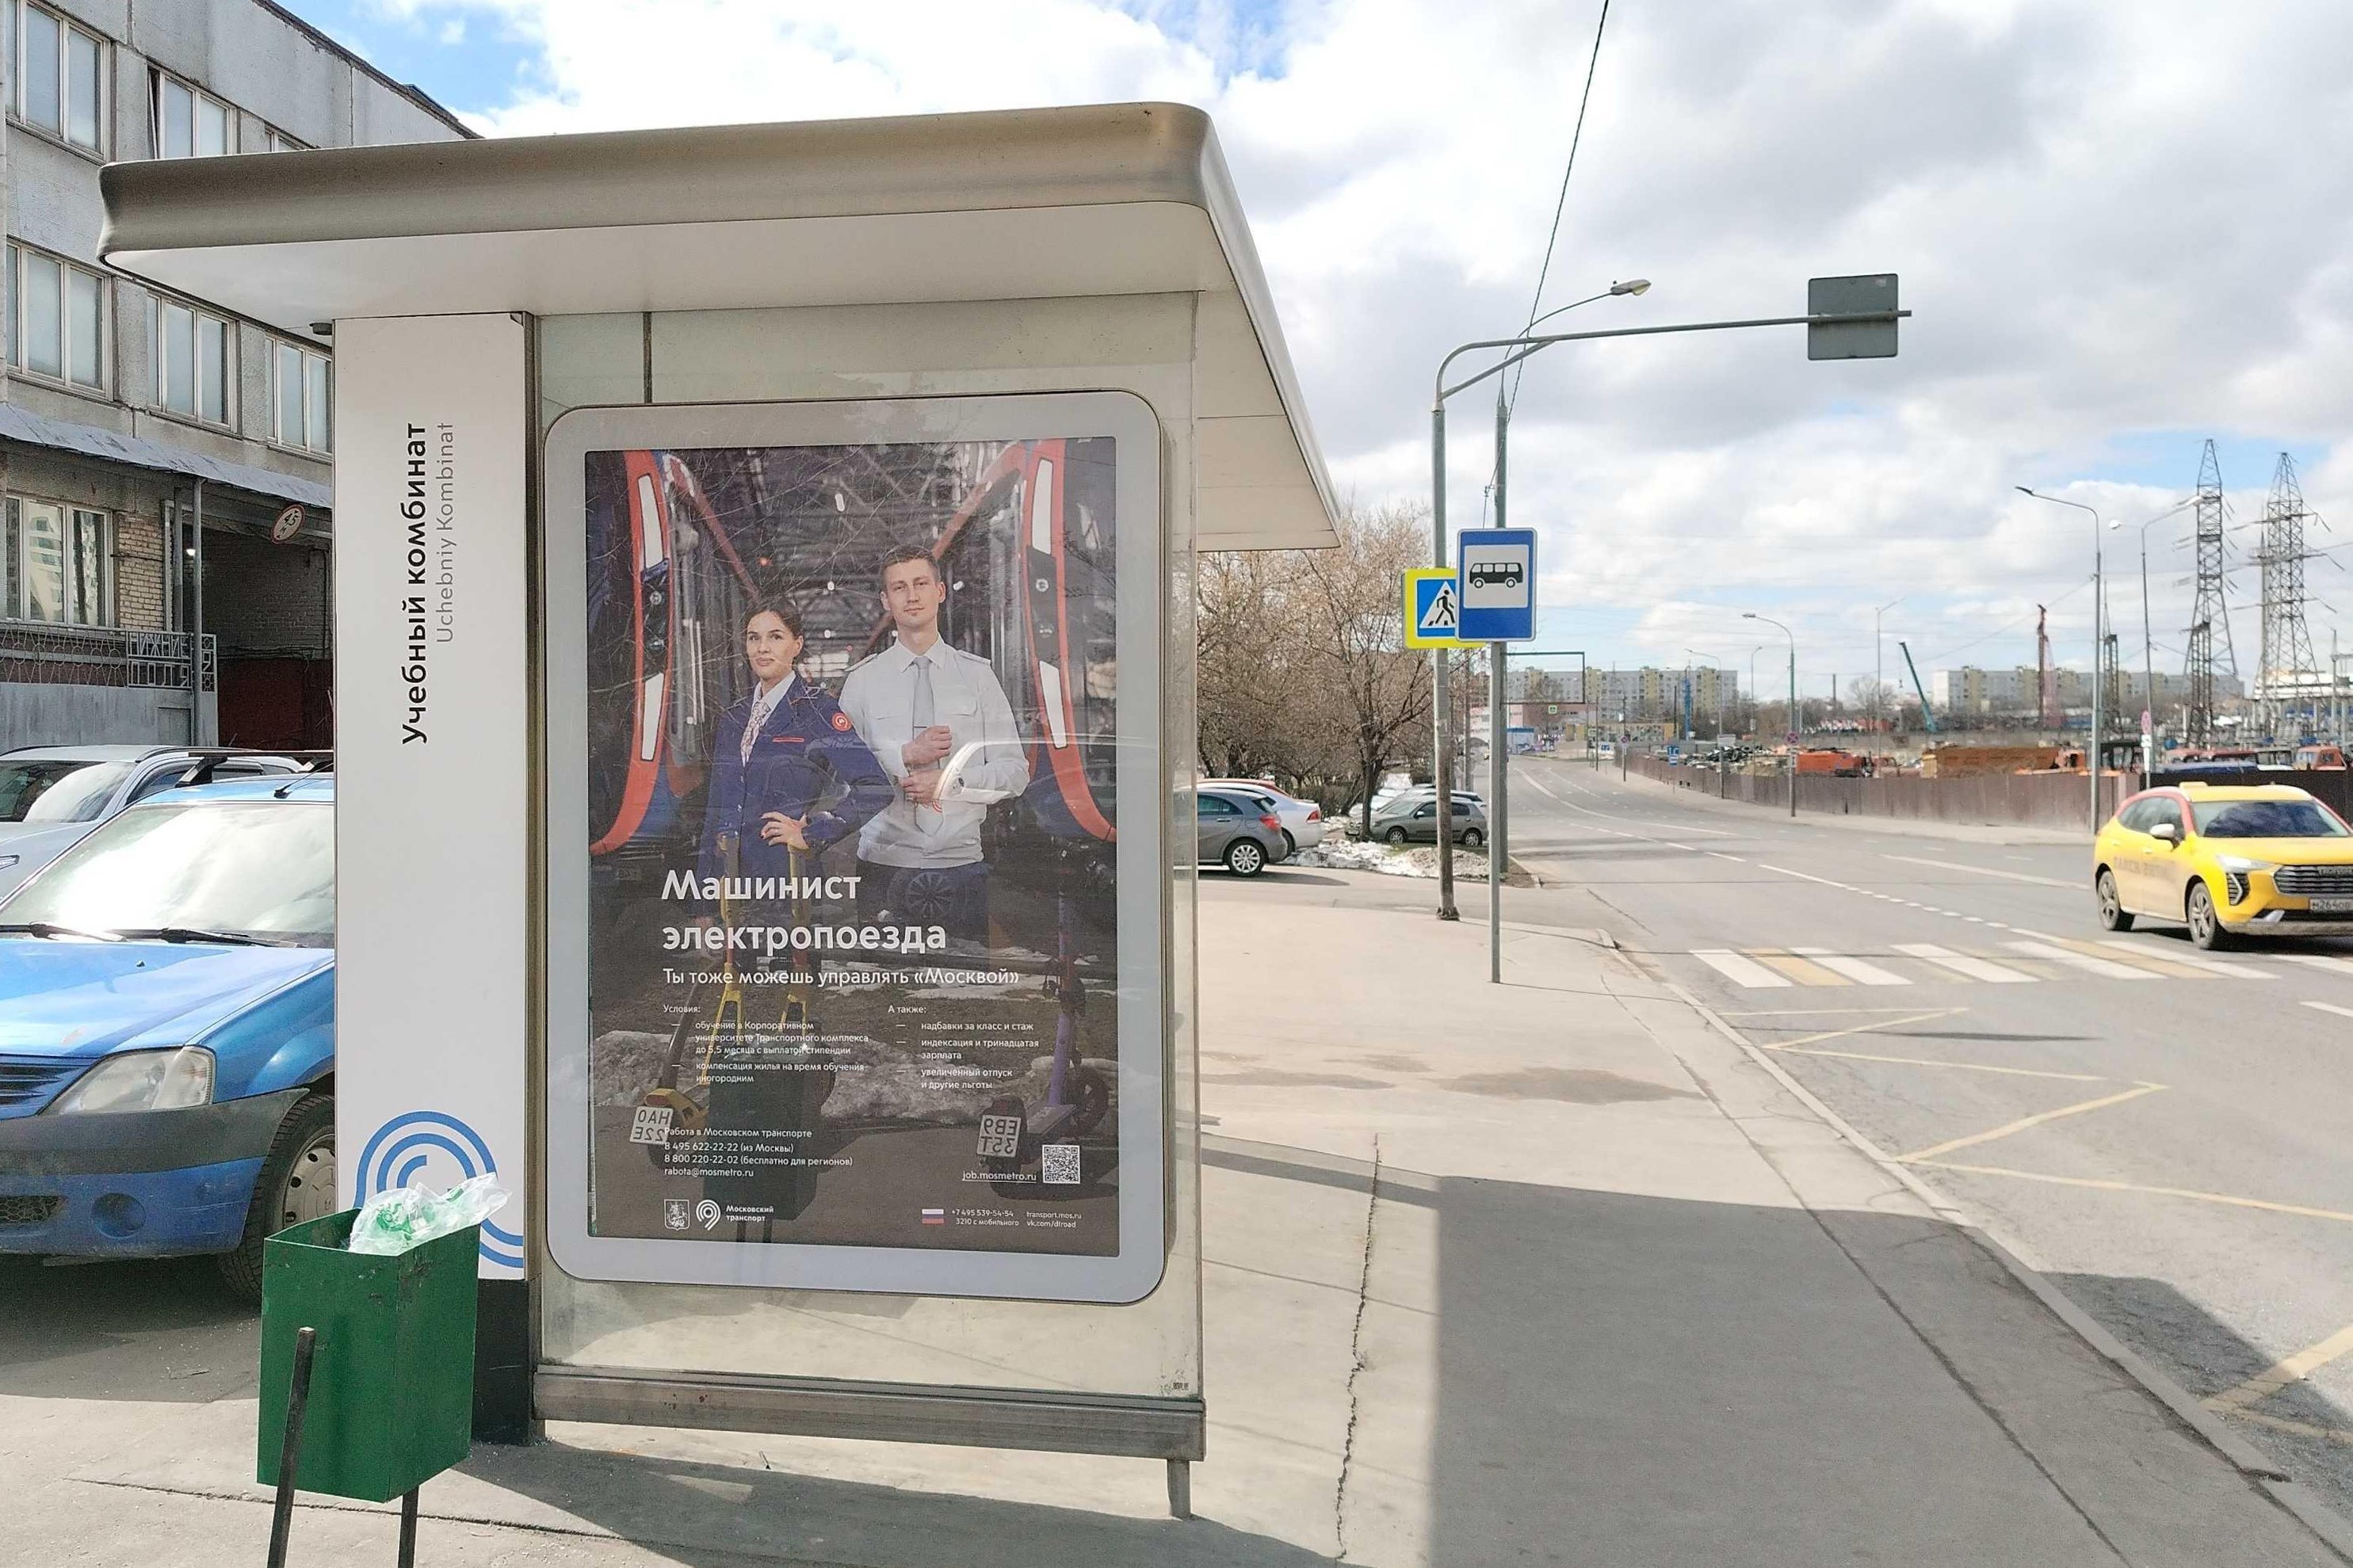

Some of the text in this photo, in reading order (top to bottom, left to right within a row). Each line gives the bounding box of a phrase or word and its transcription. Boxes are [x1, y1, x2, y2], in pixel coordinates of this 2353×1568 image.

[434, 422, 457, 643] Uchebniy Kombinat
[400, 422, 428, 745] Учебный комбинат
[661, 869, 862, 901] Машинист
[662, 924, 947, 956] электропоезда
[663, 967, 1020, 987] Ты тоже можешь управлять «Москвой»
[663, 1005, 701, 1014] Условия:
[888, 1005, 895, 1013] А
[695, 1021, 735, 1032] обучение
[744, 1021, 814, 1032] Корпоративном
[921, 1021, 963, 1032] надбавки
[695, 1034, 869, 1044] университете Транспортного комплекса
[921, 1040, 973, 1048] индексация
[983, 1040, 1039, 1049] тринадцатая
[724, 1047, 755, 1056] месяца
[763, 1046, 804, 1055] выплатой
[806, 1047, 851, 1056] стипендии
[696, 1063, 753, 1072] компенсация
[794, 1064, 822, 1073] время
[823, 1063, 865, 1073] обучения
[921, 1068, 1013, 1078] увеличенный отпуск
[696, 1075, 754, 1085] иногородним
[929, 1082, 960, 1090] другие
[664, 1127, 695, 1136] Работа
[703, 1128, 760, 1137] Московском
[762, 1130, 813, 1139] транспорте
[664, 1142, 794, 1154] 8 495 622-22-22 (из Москвы)
[664, 1154, 854, 1168] 8 800 220-22-02 (бесплатно для регионов)
[664, 1167, 754, 1178] rabota@mosmetro.ru
[962, 1170, 1037, 1181] job.mosmetro.ru
[726, 1205, 774, 1214] Московский
